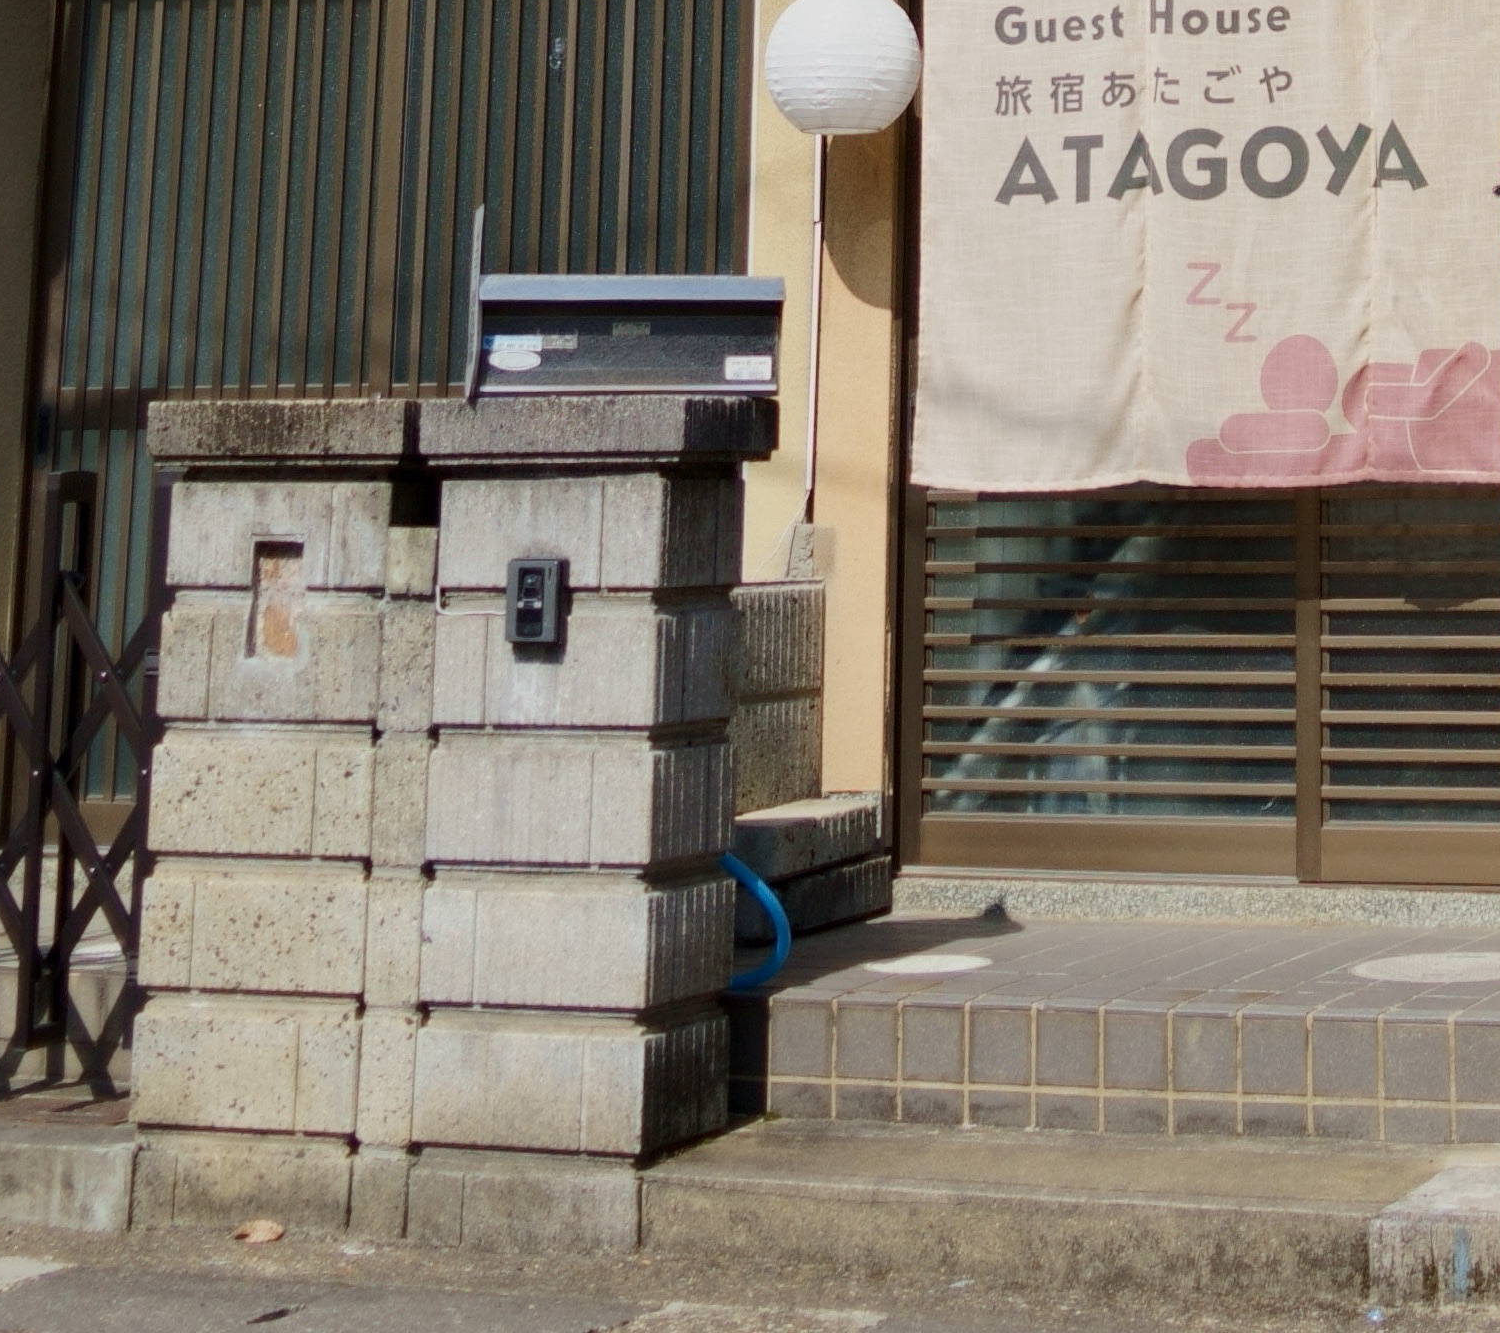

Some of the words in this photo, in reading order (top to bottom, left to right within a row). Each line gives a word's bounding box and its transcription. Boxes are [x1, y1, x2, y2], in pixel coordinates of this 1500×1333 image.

[994, 5, 1125, 45] Guest
[994, 65, 1294, 117] 旅宿あたごや
[995, 119, 1429, 205] ATAGOYA
